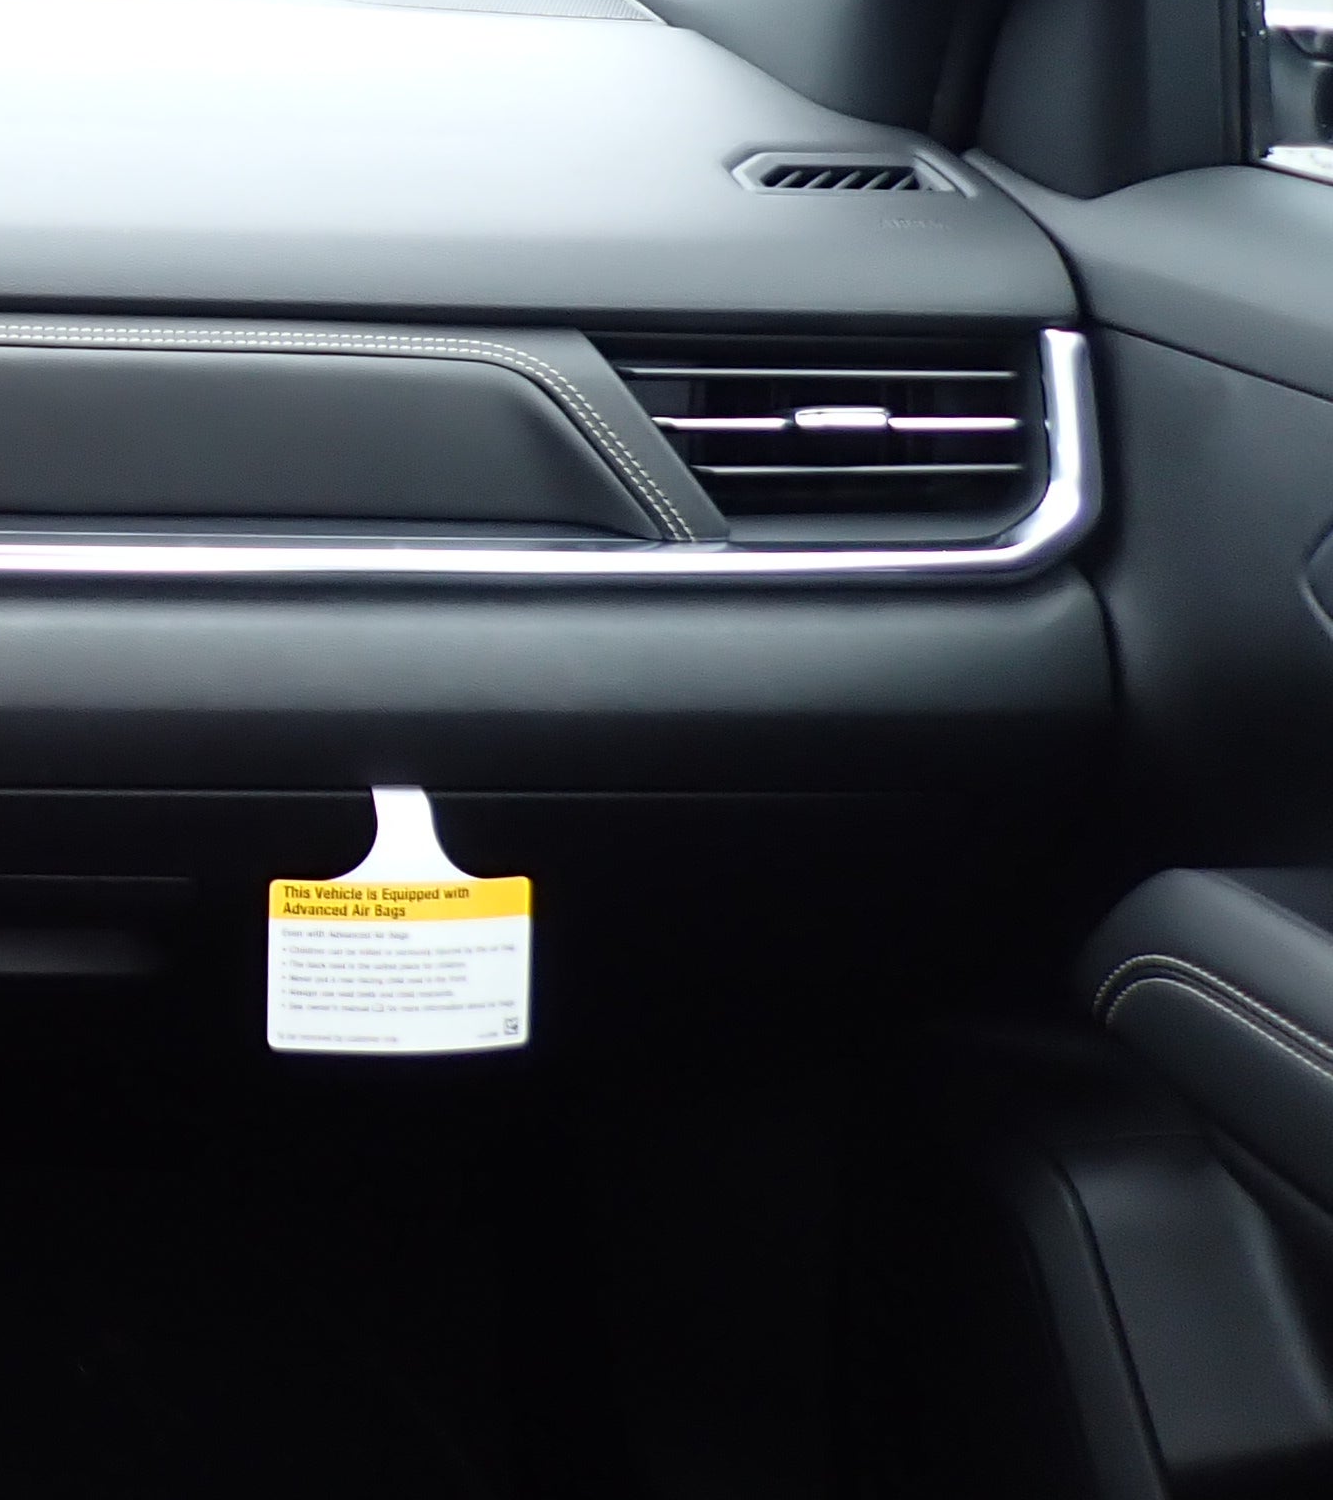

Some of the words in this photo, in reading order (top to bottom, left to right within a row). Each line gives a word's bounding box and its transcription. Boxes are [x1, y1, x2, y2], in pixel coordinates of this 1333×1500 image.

[284, 886, 310, 899] This
[314, 887, 362, 900] Vehicle
[382, 886, 439, 903] Equipped
[444, 886, 470, 899] with
[283, 902, 348, 916] Advanced
[353, 903, 370, 917] Air
[375, 904, 406, 920] Bags
